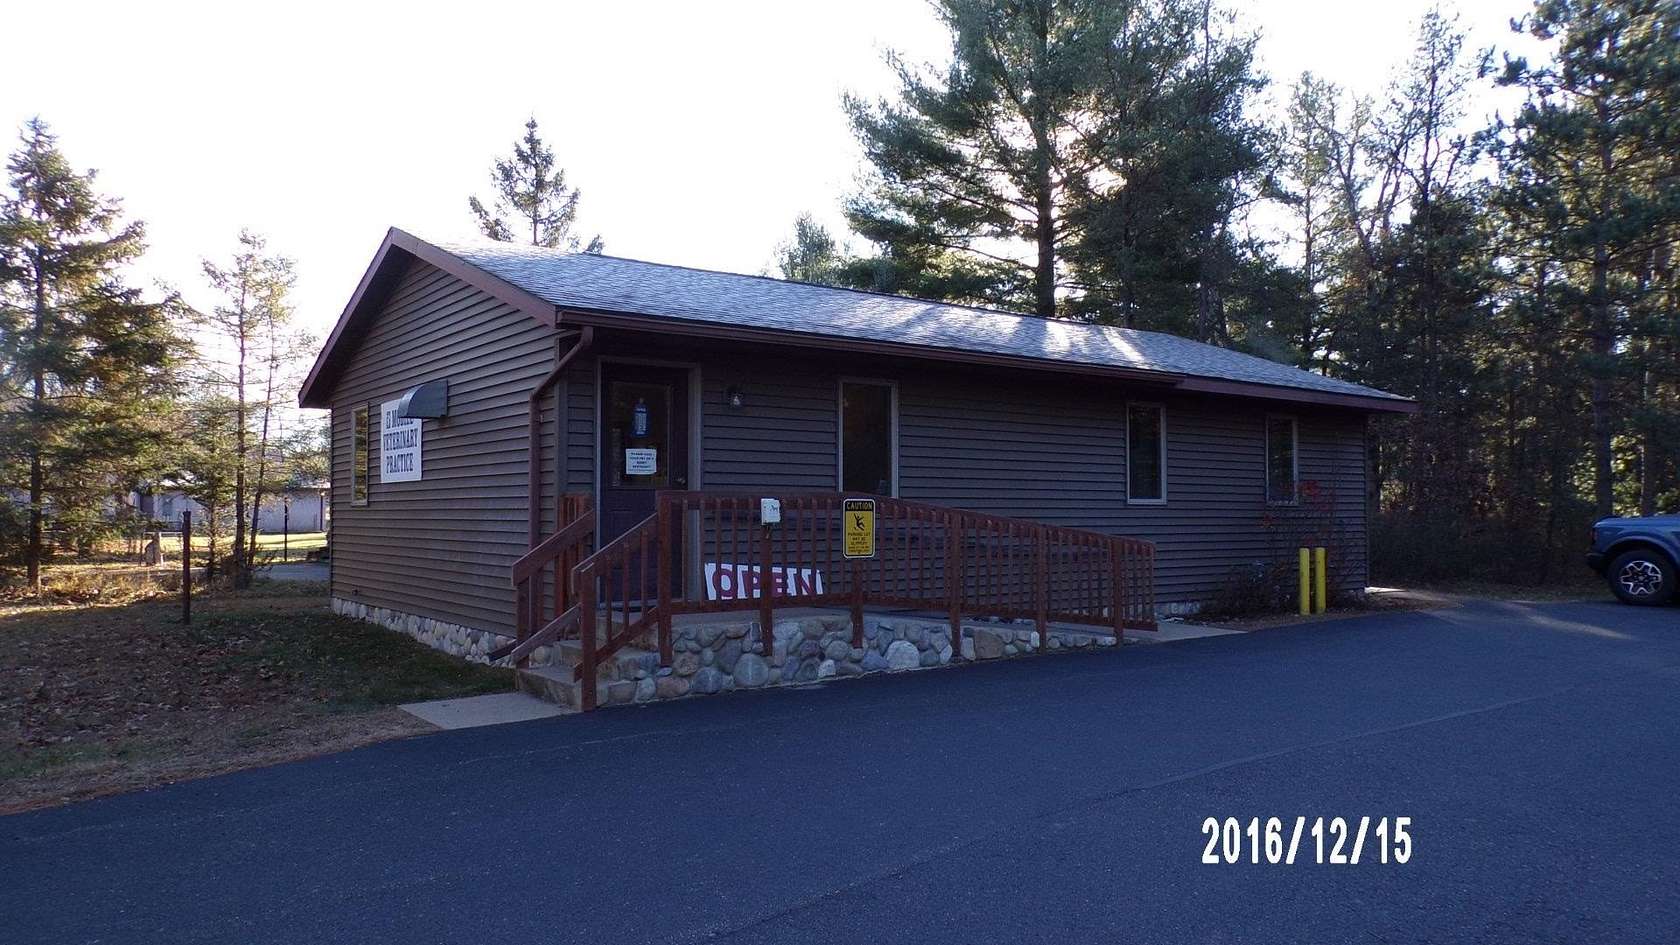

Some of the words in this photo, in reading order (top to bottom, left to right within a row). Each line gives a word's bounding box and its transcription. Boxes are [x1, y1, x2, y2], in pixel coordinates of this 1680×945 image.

[383, 428, 418, 451] VETERINARY
[386, 453, 414, 473] PRACTICE
[846, 502, 873, 510] CAUTION
[712, 566, 818, 598] OPEN
